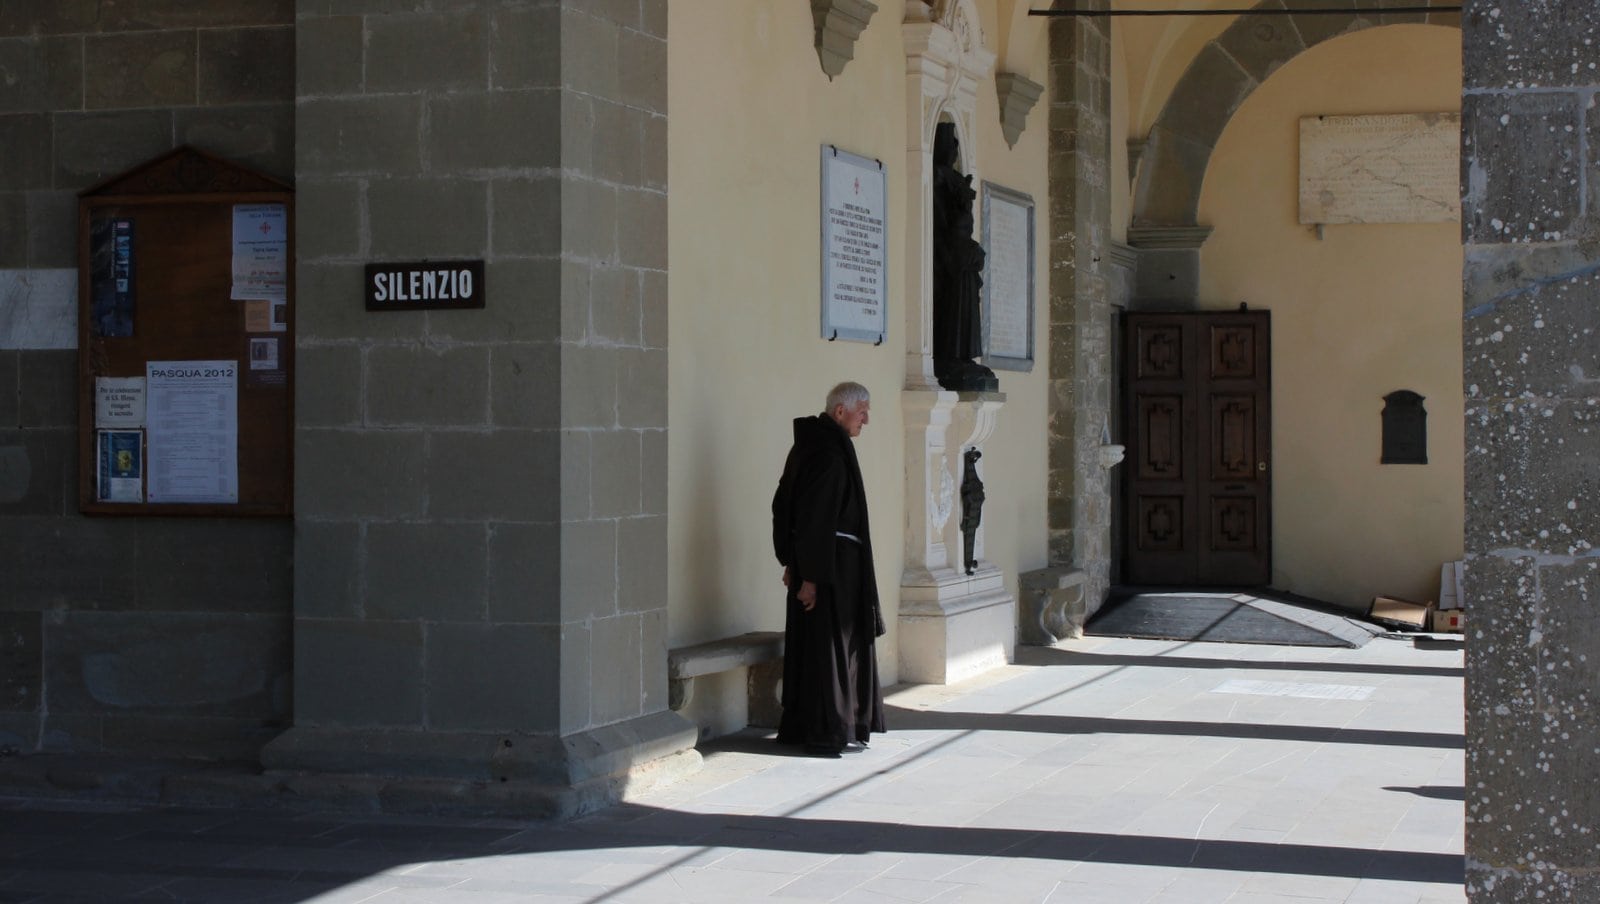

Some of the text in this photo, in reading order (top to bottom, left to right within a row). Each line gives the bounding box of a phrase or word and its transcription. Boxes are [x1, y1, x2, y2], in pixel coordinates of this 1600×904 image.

[374, 269, 473, 301] SILENZIO
[152, 369, 234, 378] PASQUA 2012
